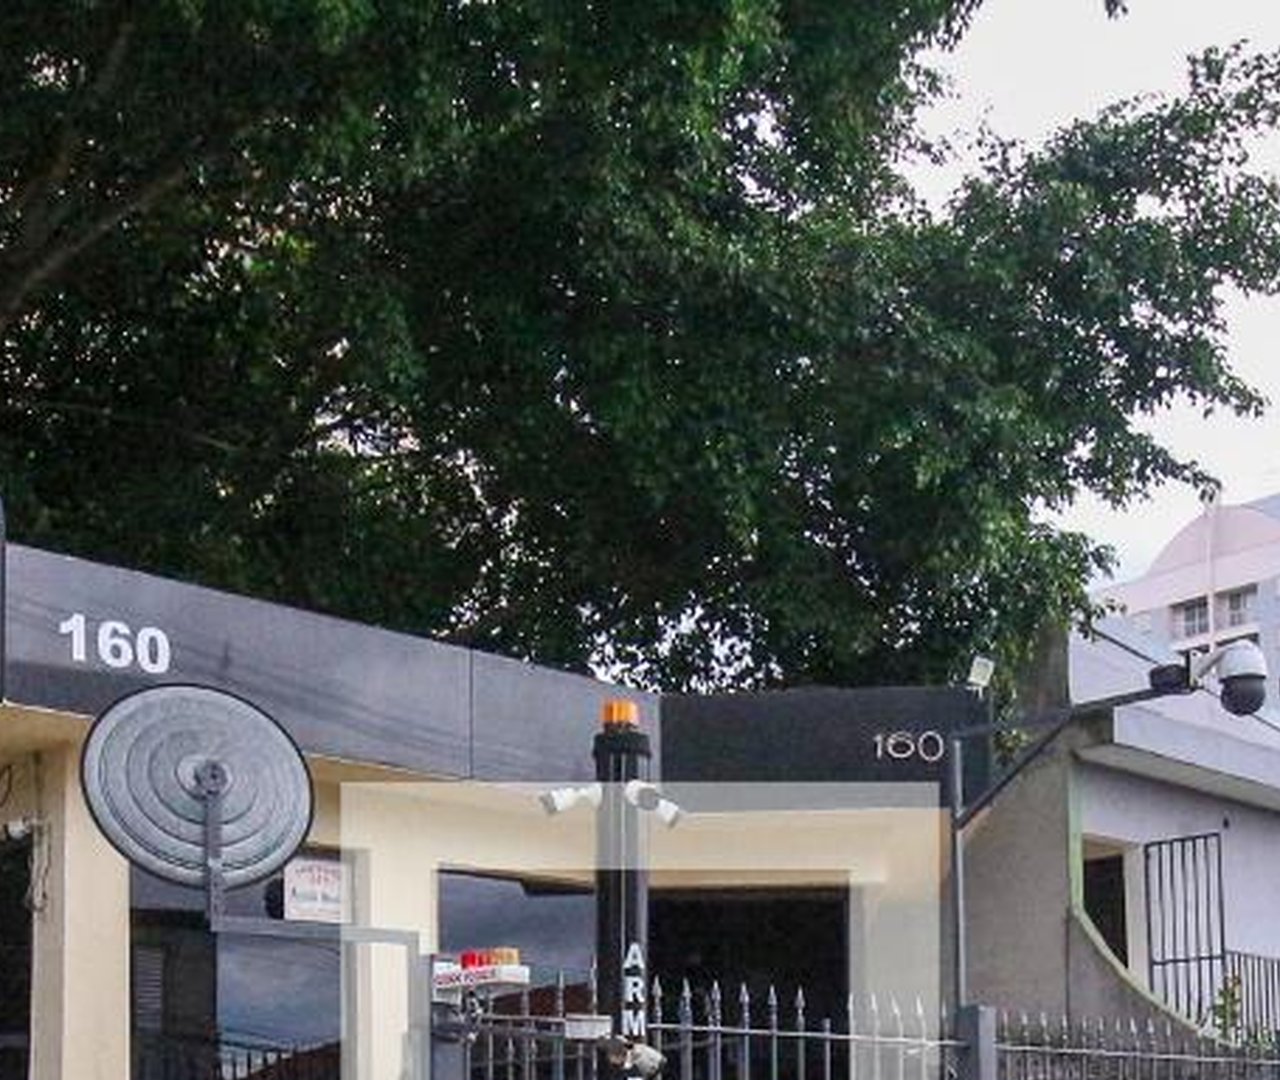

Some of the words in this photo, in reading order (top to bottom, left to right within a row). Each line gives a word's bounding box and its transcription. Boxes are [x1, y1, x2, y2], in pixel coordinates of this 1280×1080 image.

[60, 613, 170, 673] 160
[873, 731, 943, 761] 160
[622, 942, 646, 1069] ARM
